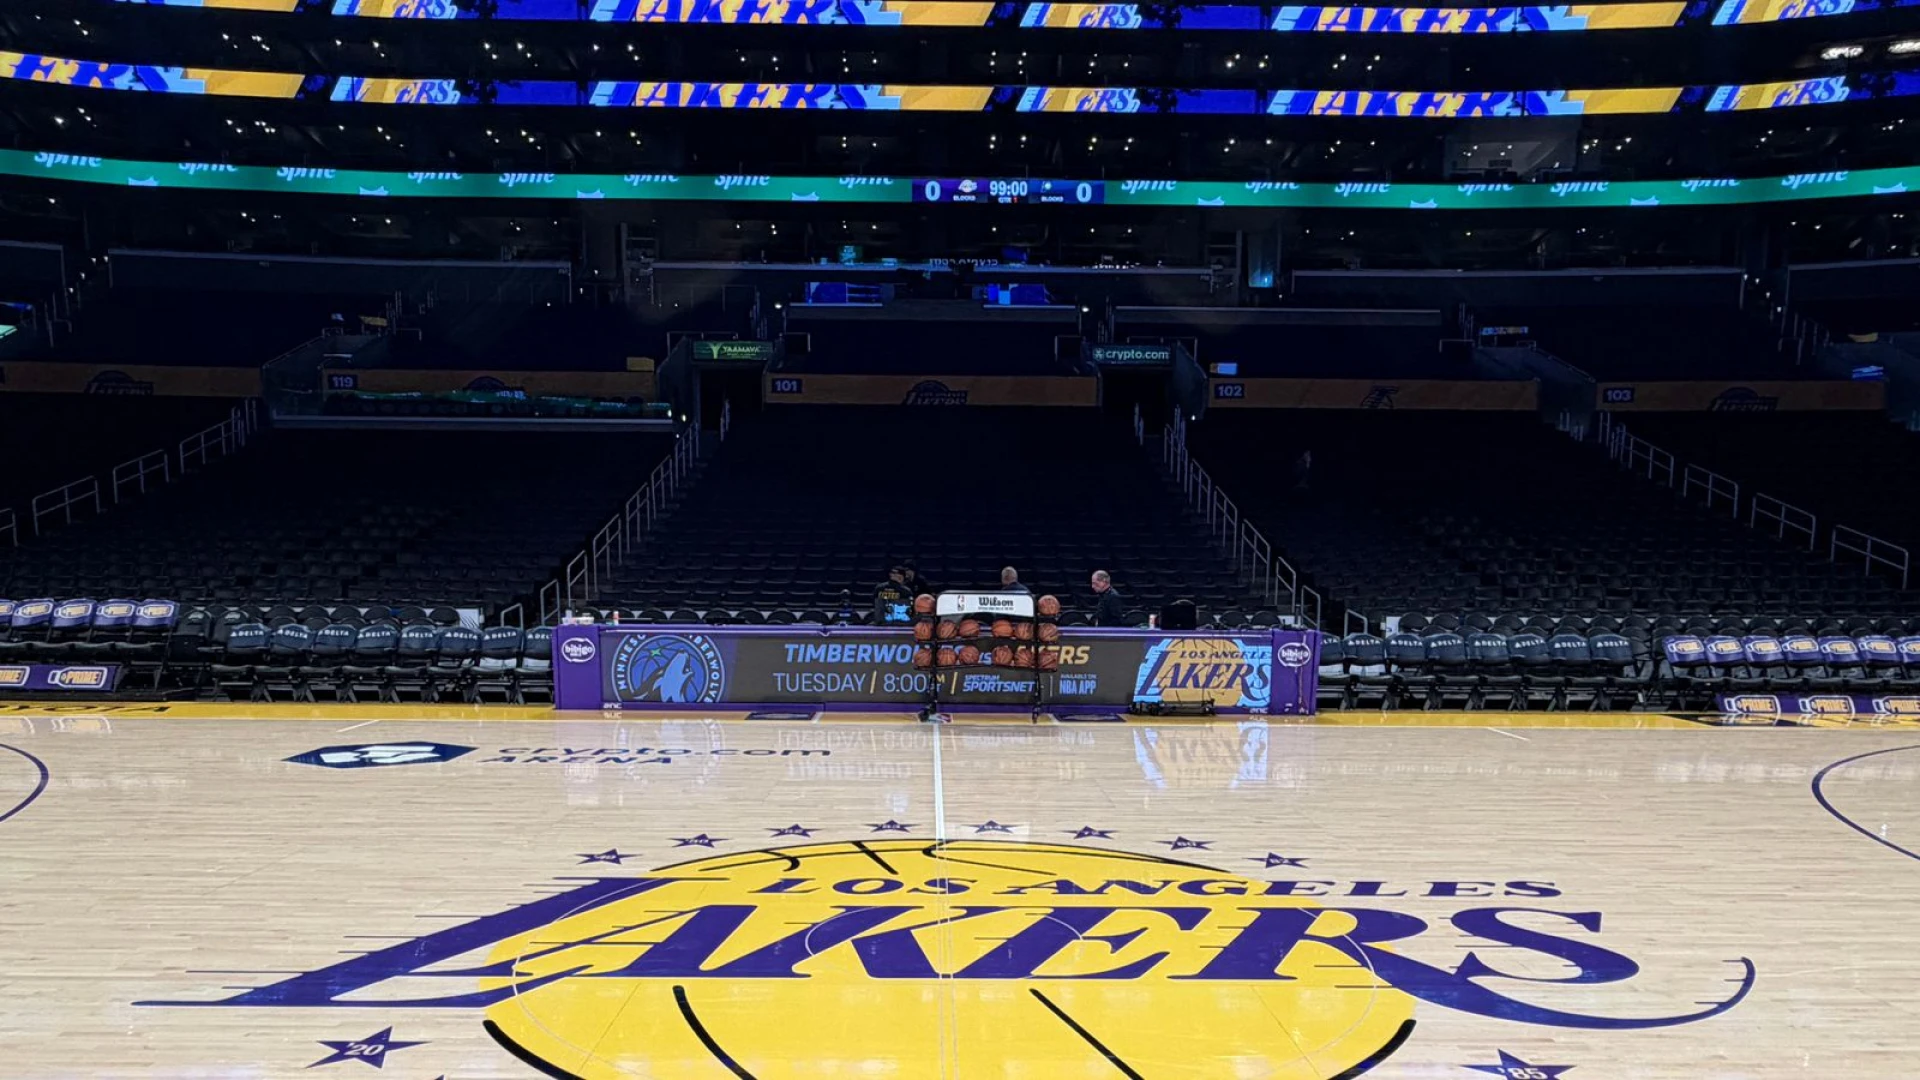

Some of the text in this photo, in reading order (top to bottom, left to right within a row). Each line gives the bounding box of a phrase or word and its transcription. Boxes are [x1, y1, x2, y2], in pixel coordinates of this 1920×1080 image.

[925, 181, 941, 201] 0
[989, 181, 1028, 196] 99:00
[1076, 183, 1092, 203] 0
[1105, 348, 1169, 361] crypto.com
[332, 375, 354, 388] 119
[775, 379, 798, 392] 101
[1217, 384, 1242, 397] 102
[1606, 389, 1632, 401] 103
[979, 597, 1013, 606] Wilson
[284, 630, 308, 639] DELTA
[366, 630, 391, 638] DELTA
[453, 632, 478, 640] DELTA
[491, 631, 517, 639] DELTA
[1180, 650, 1271, 659] LOS ANGELE
[65, 671, 102, 684] PRIME
[1136, 650, 1271, 701] LAKERS
[773, 673, 927, 692] TUESDAY 8:00
[962, 681, 1036, 692] SPORTSNET
[1059, 680, 1097, 695] NBA APP
[498, 747, 832, 757] crypto.com
[476, 756, 671, 764] ARENA
[747, 878, 1562, 898] LOS ANGELES
[131, 877, 1756, 1030] LAKERS
[343, 1042, 385, 1056] '20
[1496, 1067, 1549, 1080] '85
